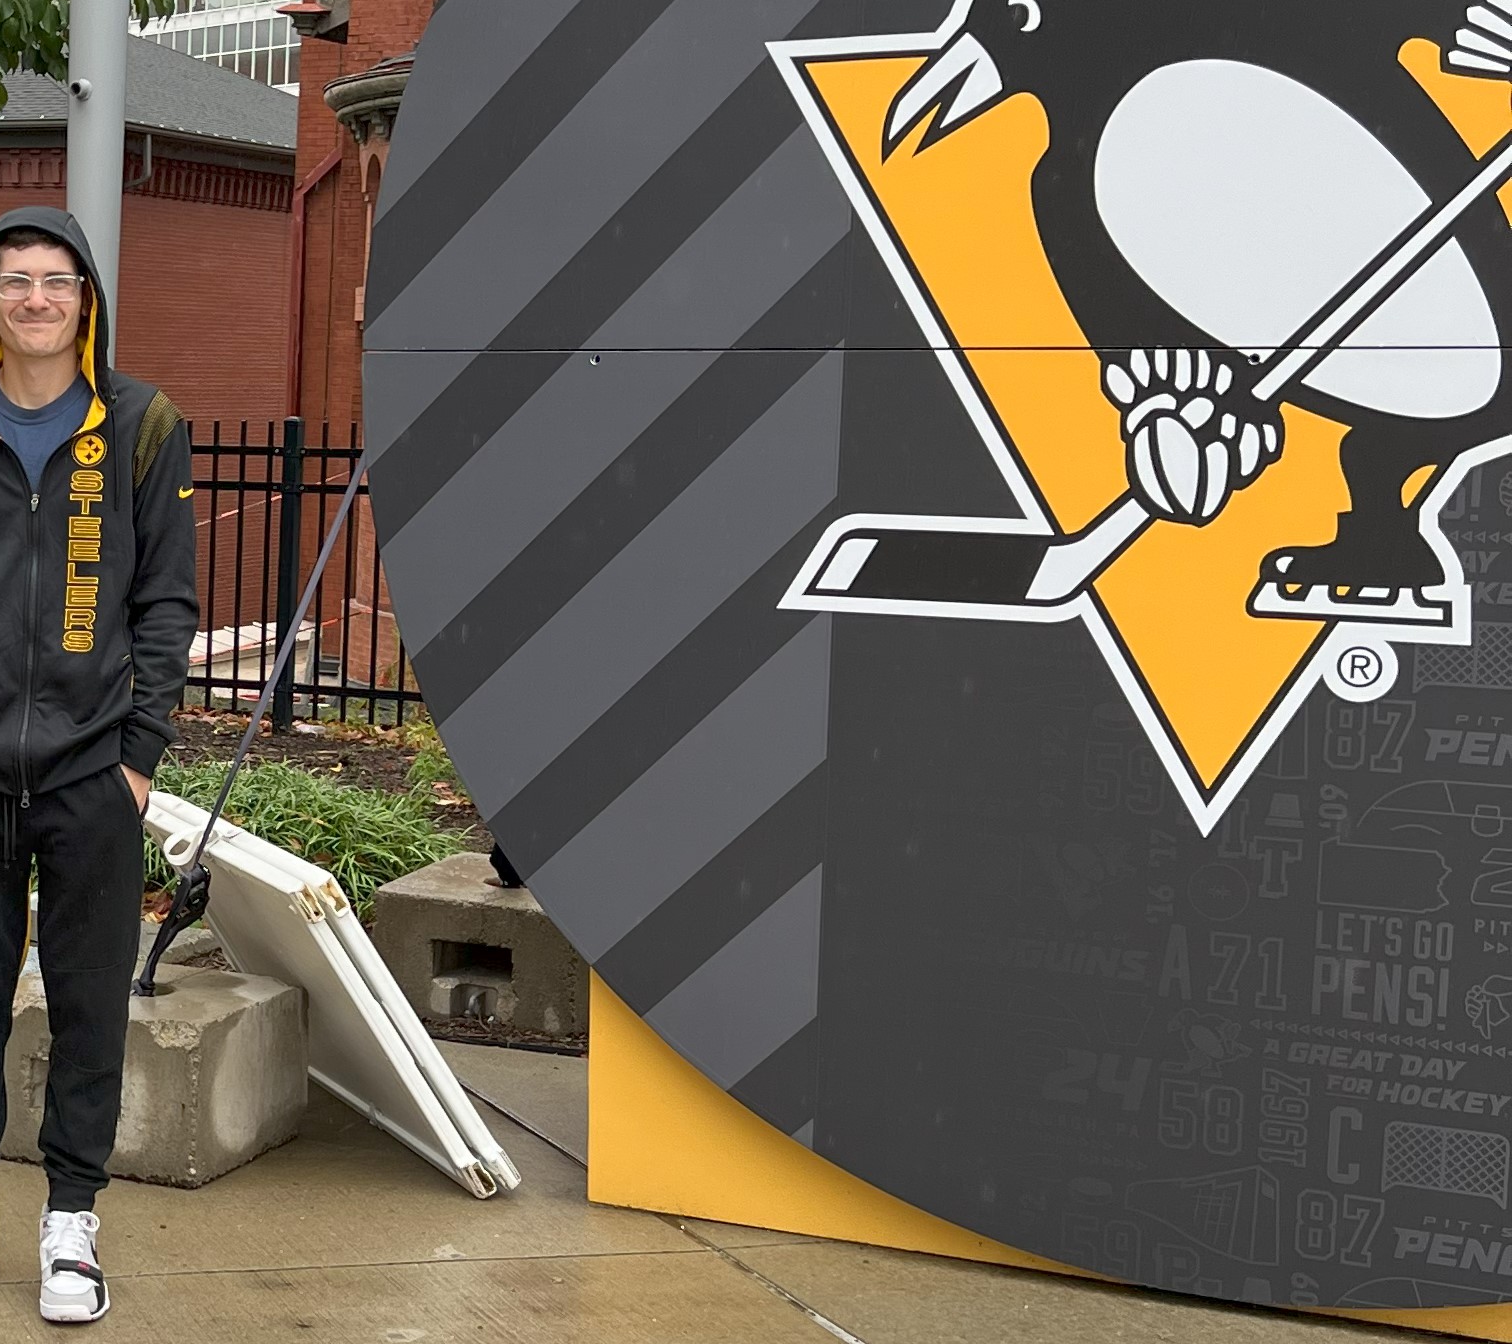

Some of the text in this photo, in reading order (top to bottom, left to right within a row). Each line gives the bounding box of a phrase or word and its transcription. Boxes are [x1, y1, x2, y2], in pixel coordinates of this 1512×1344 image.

[62, 469, 104, 653] STEELERS
[1158, 923, 1287, 1012] A 71
[1315, 909, 1454, 962] LET'S GO
[1311, 955, 1450, 1032] PENS!
[1287, 1041, 1394, 1073] GREAT
[1399, 1054, 1468, 1082] DAY
[1326, 1073, 1374, 1095] FOR
[1157, 1077, 1244, 1156] 58
[1257, 1066, 1311, 1168] 1967
[1326, 1105, 1364, 1185] C
[1294, 1187, 1386, 1269] 87
